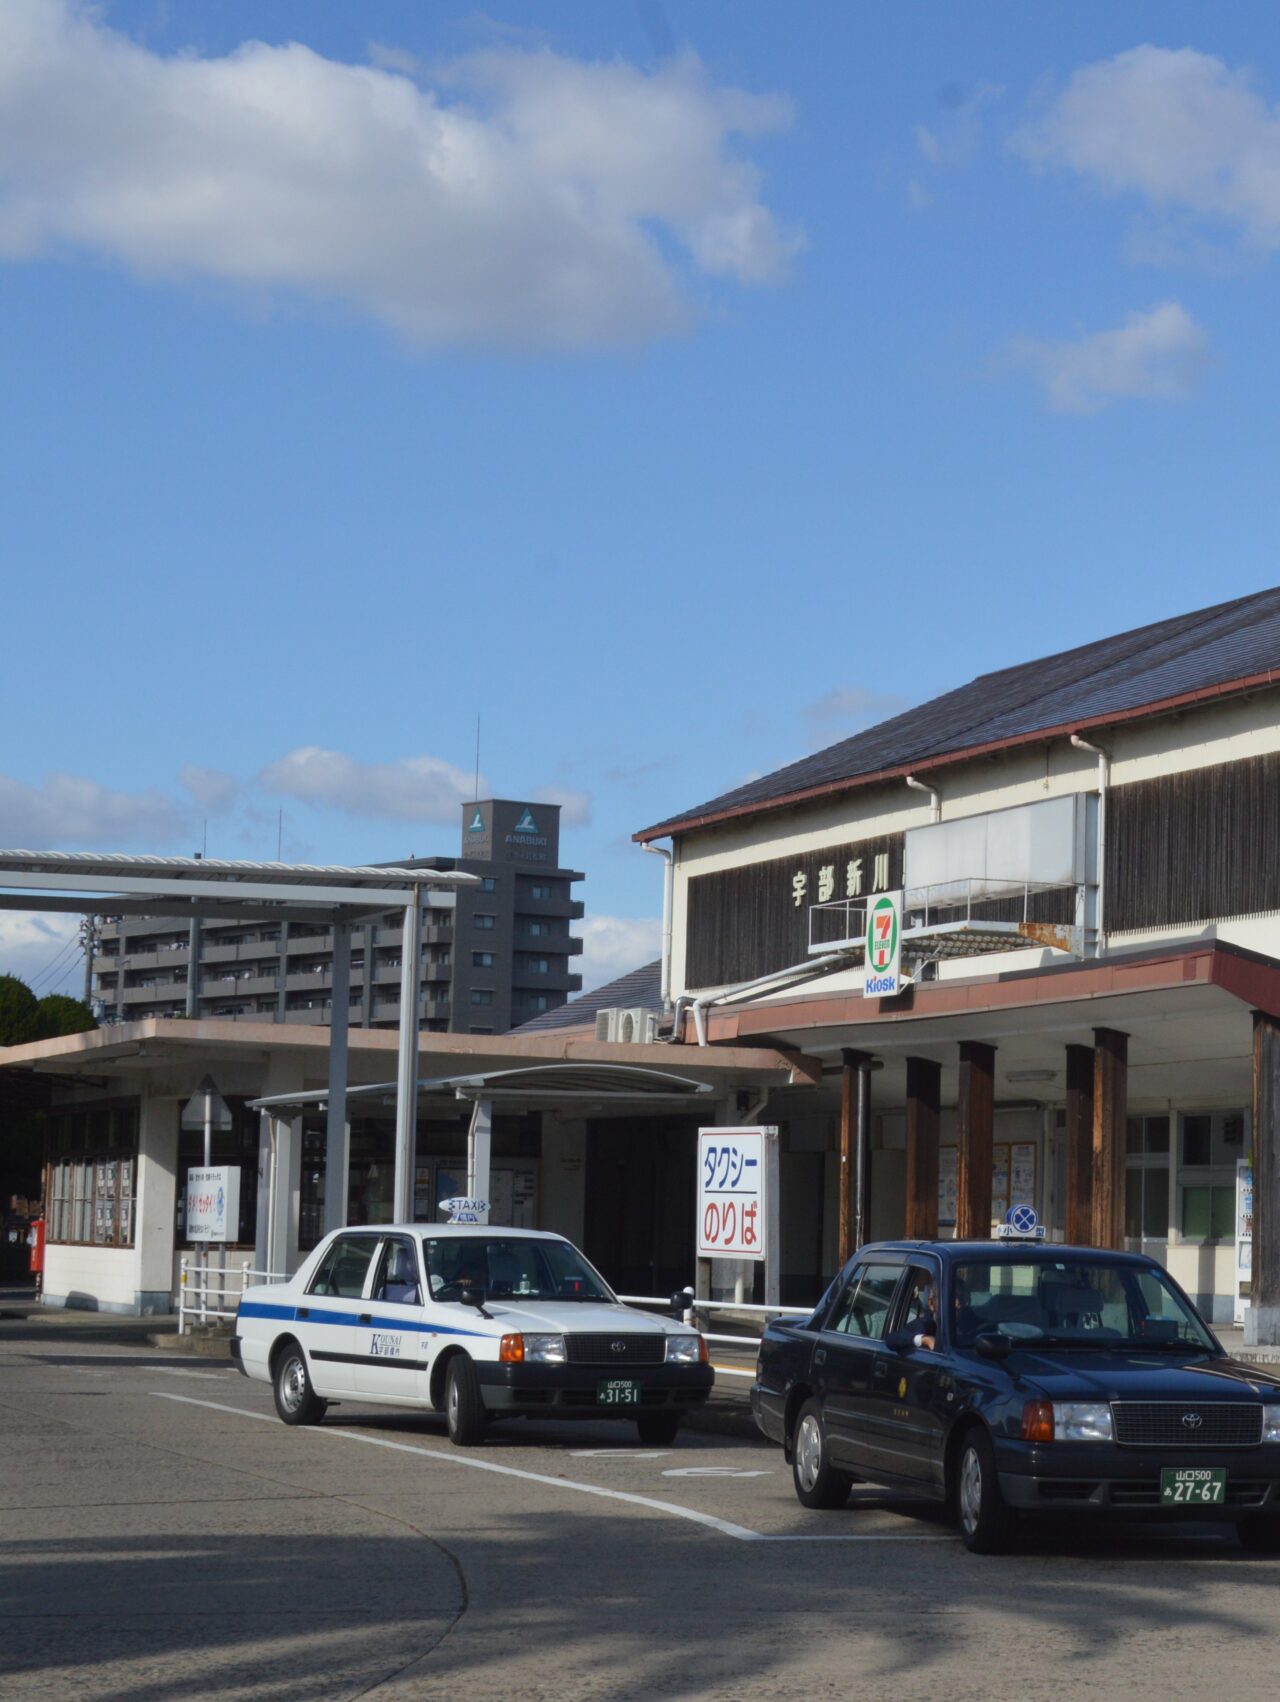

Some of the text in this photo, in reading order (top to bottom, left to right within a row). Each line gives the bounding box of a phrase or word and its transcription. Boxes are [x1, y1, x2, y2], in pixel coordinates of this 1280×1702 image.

[792, 850, 906, 907] 宇部新川
[866, 976, 896, 993] Kiosk
[704, 1147, 758, 1188] タクシー
[456, 1200, 481, 1210] TAXI
[704, 1200, 758, 1246] のりば
[606, 1388, 638, 1403] 31-51
[1176, 1470, 1212, 1481] 山口500
[1173, 1482, 1222, 1501] 27-67
